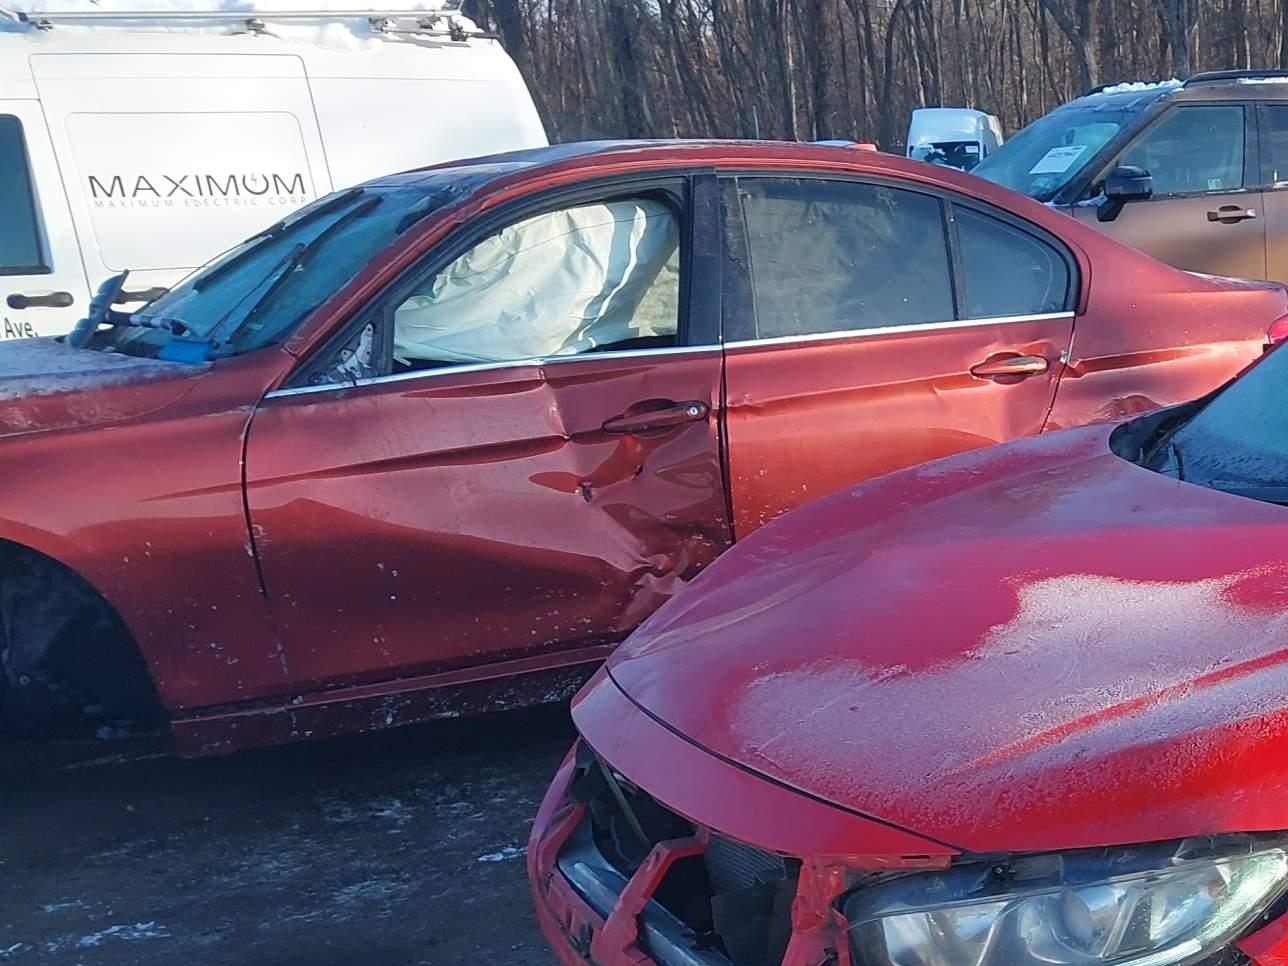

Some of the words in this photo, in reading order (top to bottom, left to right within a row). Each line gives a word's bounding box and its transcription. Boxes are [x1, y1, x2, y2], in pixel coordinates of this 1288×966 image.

[88, 172, 306, 198] MAXIMUM
[94, 199, 175, 208] MAXIMUM
[4, 316, 39, 338] Ave.
